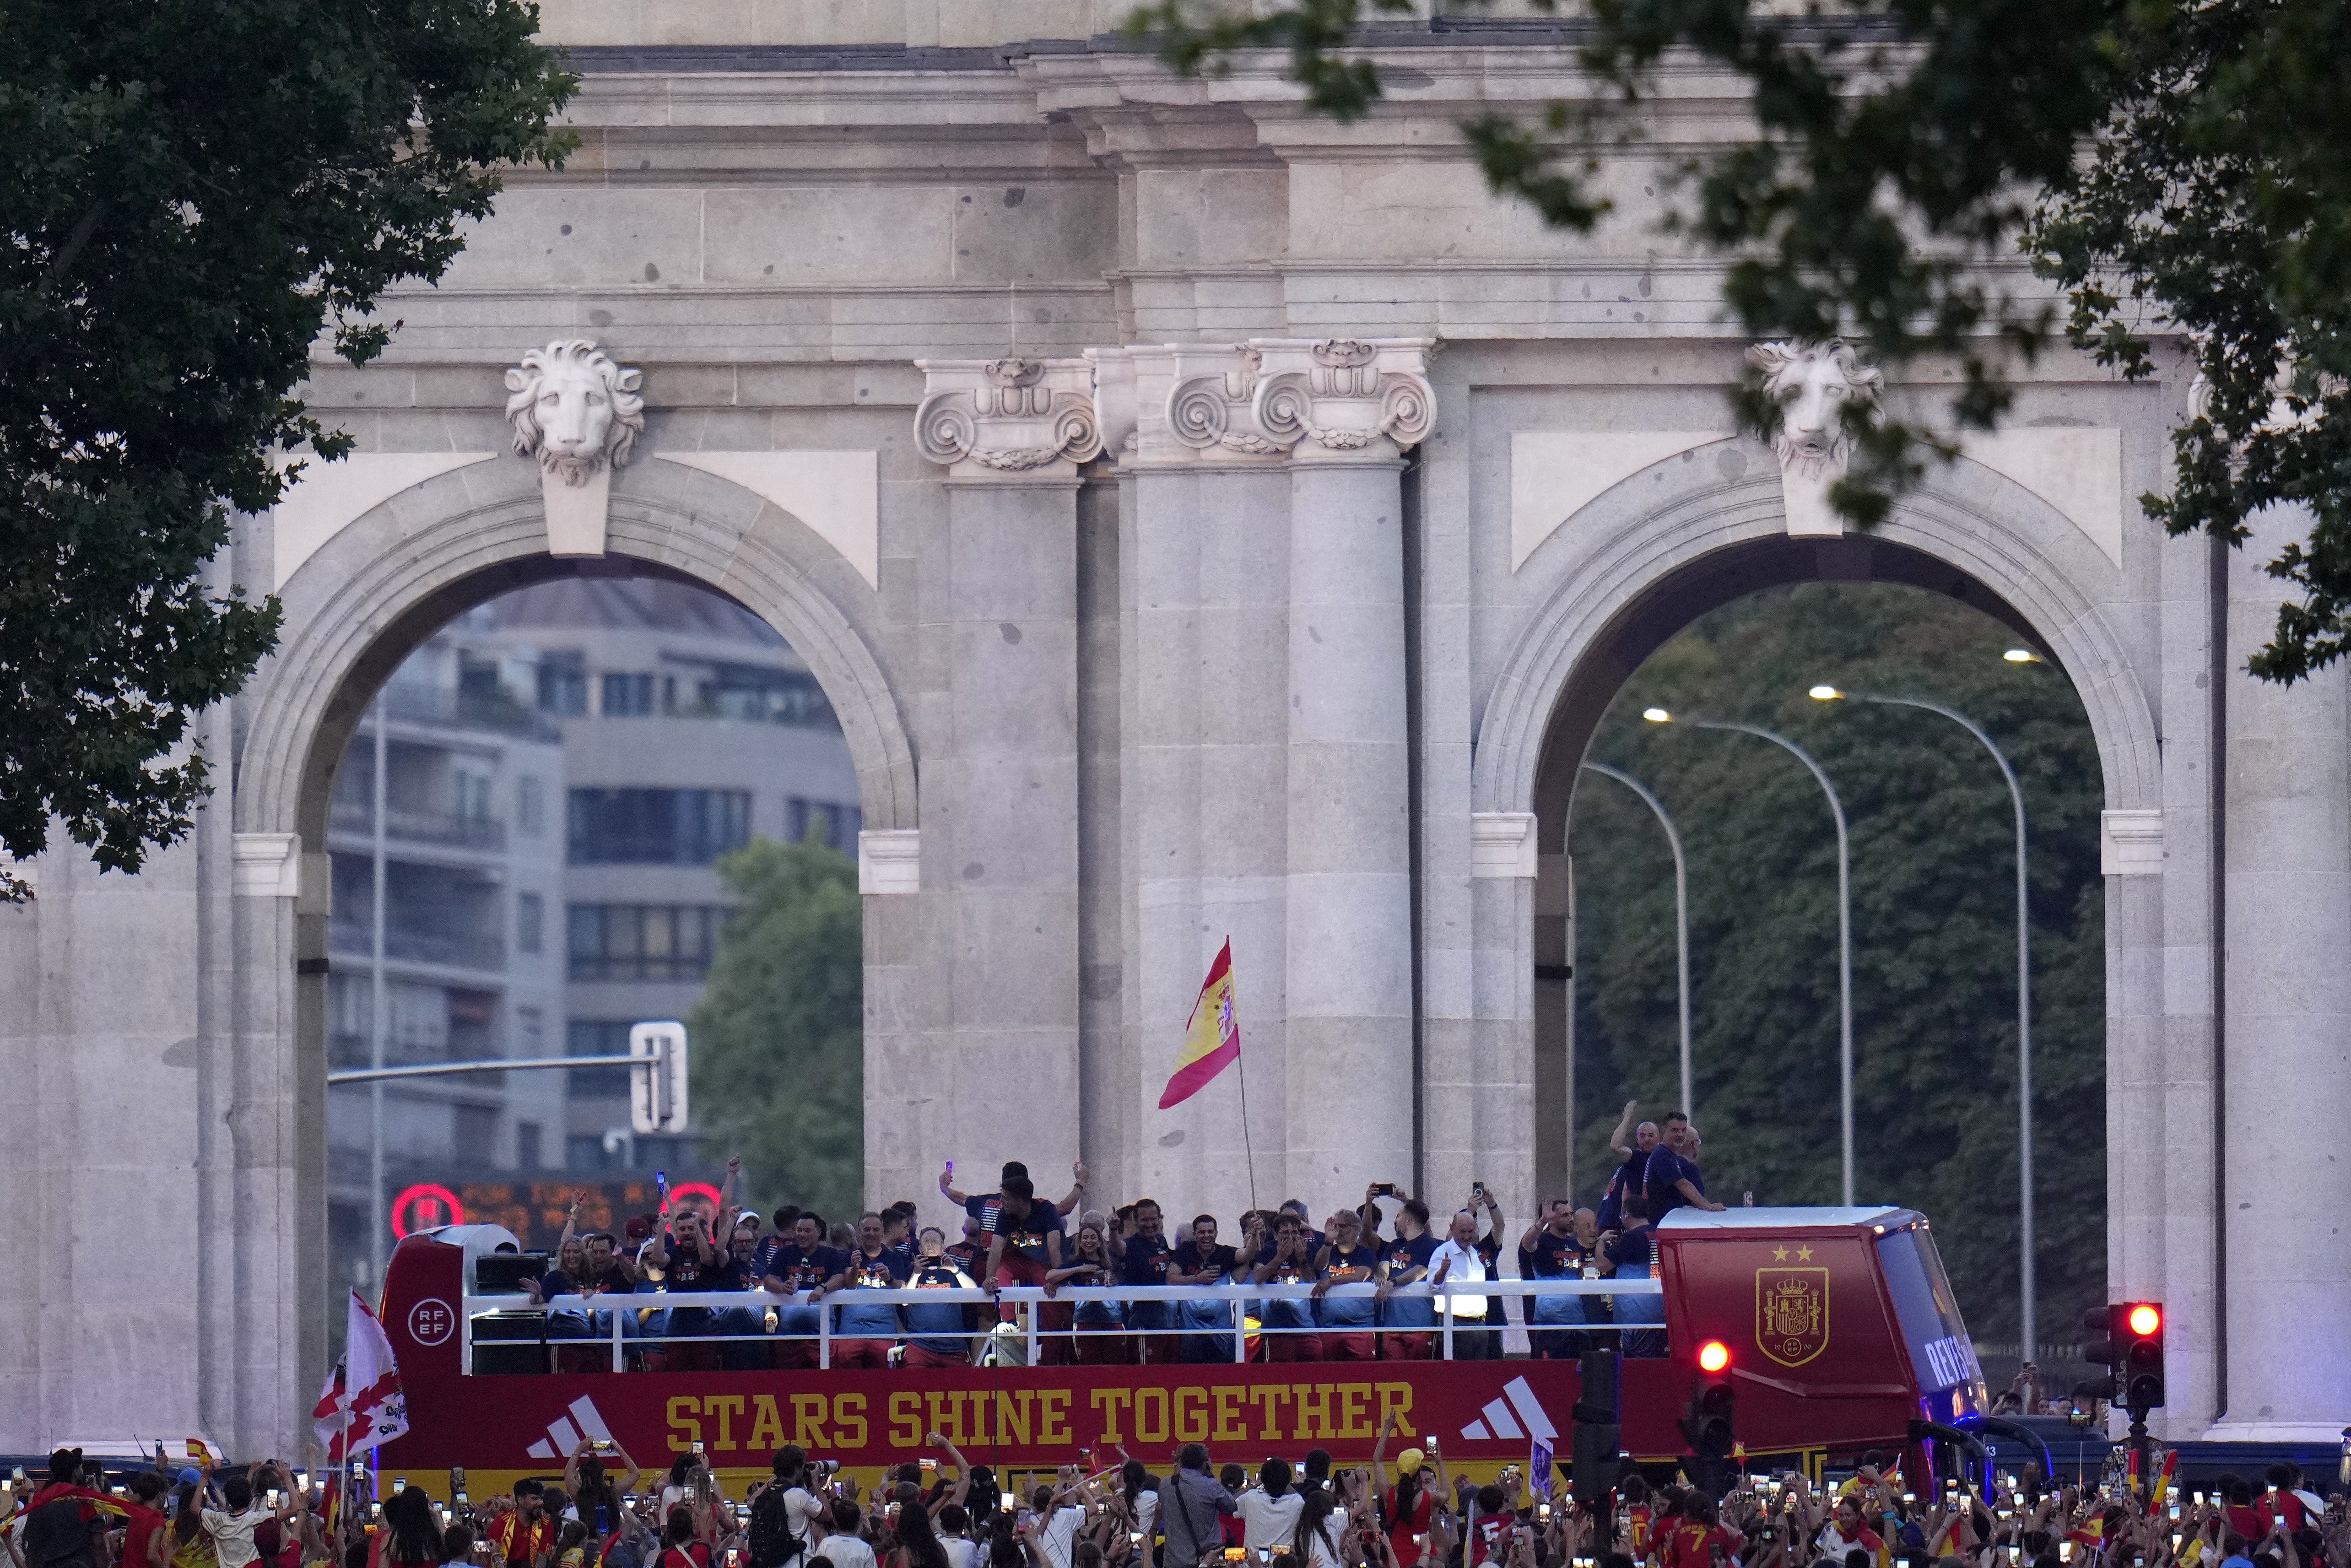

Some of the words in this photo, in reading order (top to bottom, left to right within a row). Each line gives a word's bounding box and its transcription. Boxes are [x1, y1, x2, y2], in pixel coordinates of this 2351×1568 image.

[420, 1311, 443, 1320] RF
[420, 1324, 443, 1334] EF
[667, 1394, 867, 1451] STARS
[889, 1390, 1072, 1447] SHINE
[1091, 1382, 1416, 1444] TOGETHER
[1691, 1530, 1707, 1552] 7
